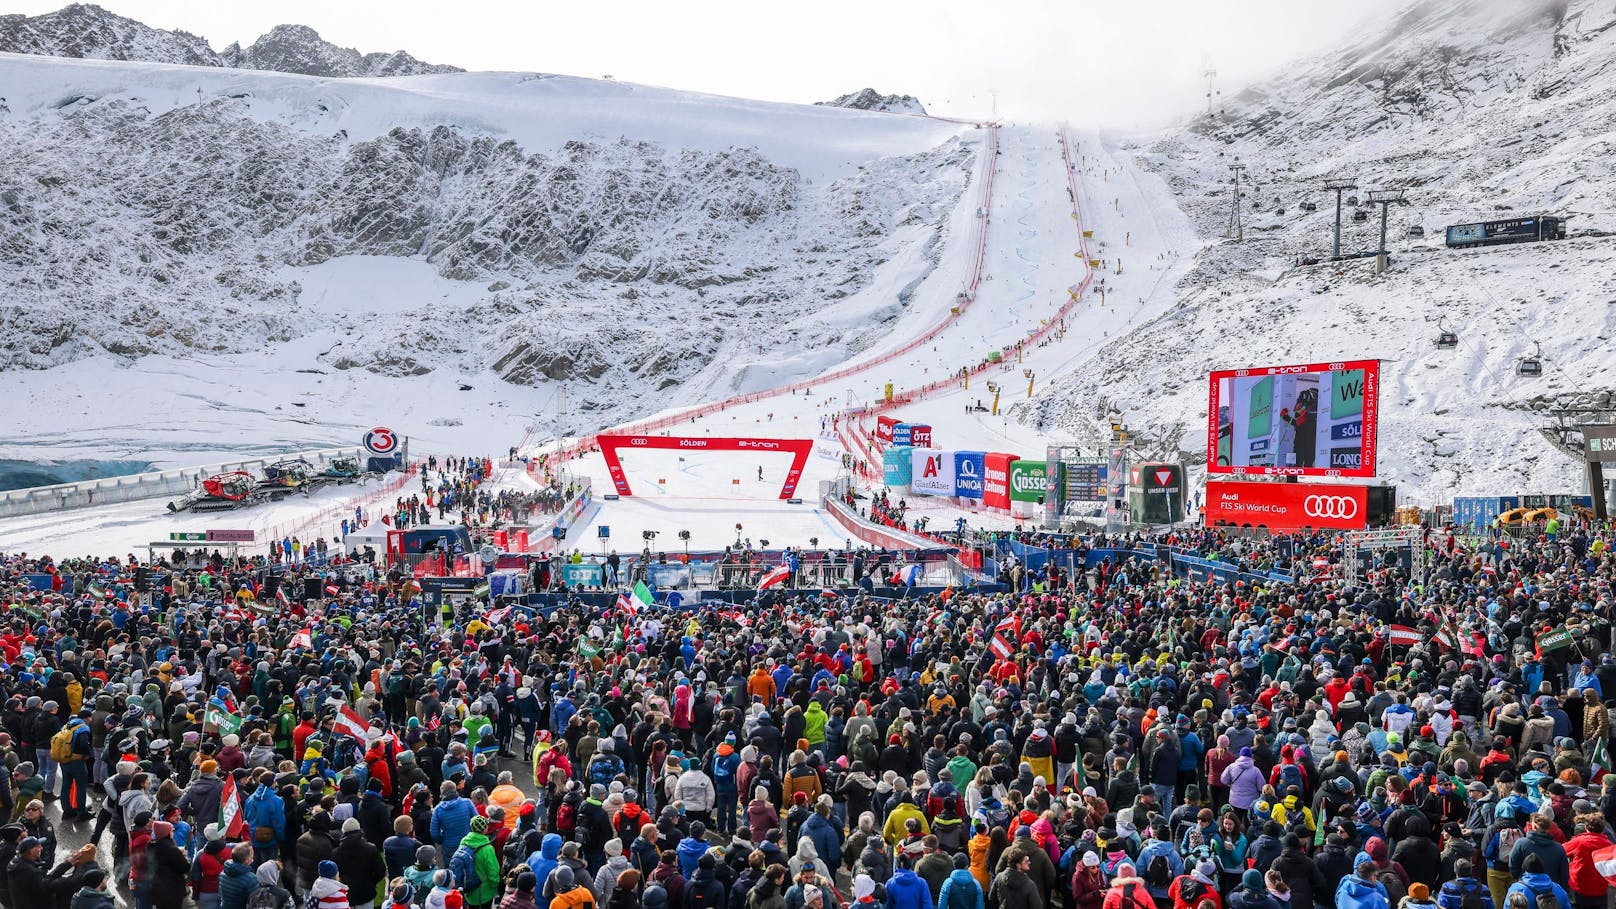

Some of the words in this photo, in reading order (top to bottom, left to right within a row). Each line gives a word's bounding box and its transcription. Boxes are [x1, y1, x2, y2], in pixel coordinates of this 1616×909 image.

[1367, 372, 1375, 392] Audi
[914, 430, 930, 441] ÖTZ
[1342, 424, 1362, 437] SÖL
[1365, 422, 1373, 448] World
[923, 454, 942, 478] A1
[1364, 450, 1372, 466] Cup
[984, 466, 1006, 482] Kronen
[1011, 468, 1047, 493] Gösse
[956, 479, 982, 490] UNIQA
[984, 480, 1006, 496] Zeitung
[1221, 493, 1239, 501] Audi
[1220, 502, 1233, 510] FIS
[1234, 502, 1245, 511] Ski
[1246, 503, 1270, 512] World
[1271, 505, 1287, 514] Cup
